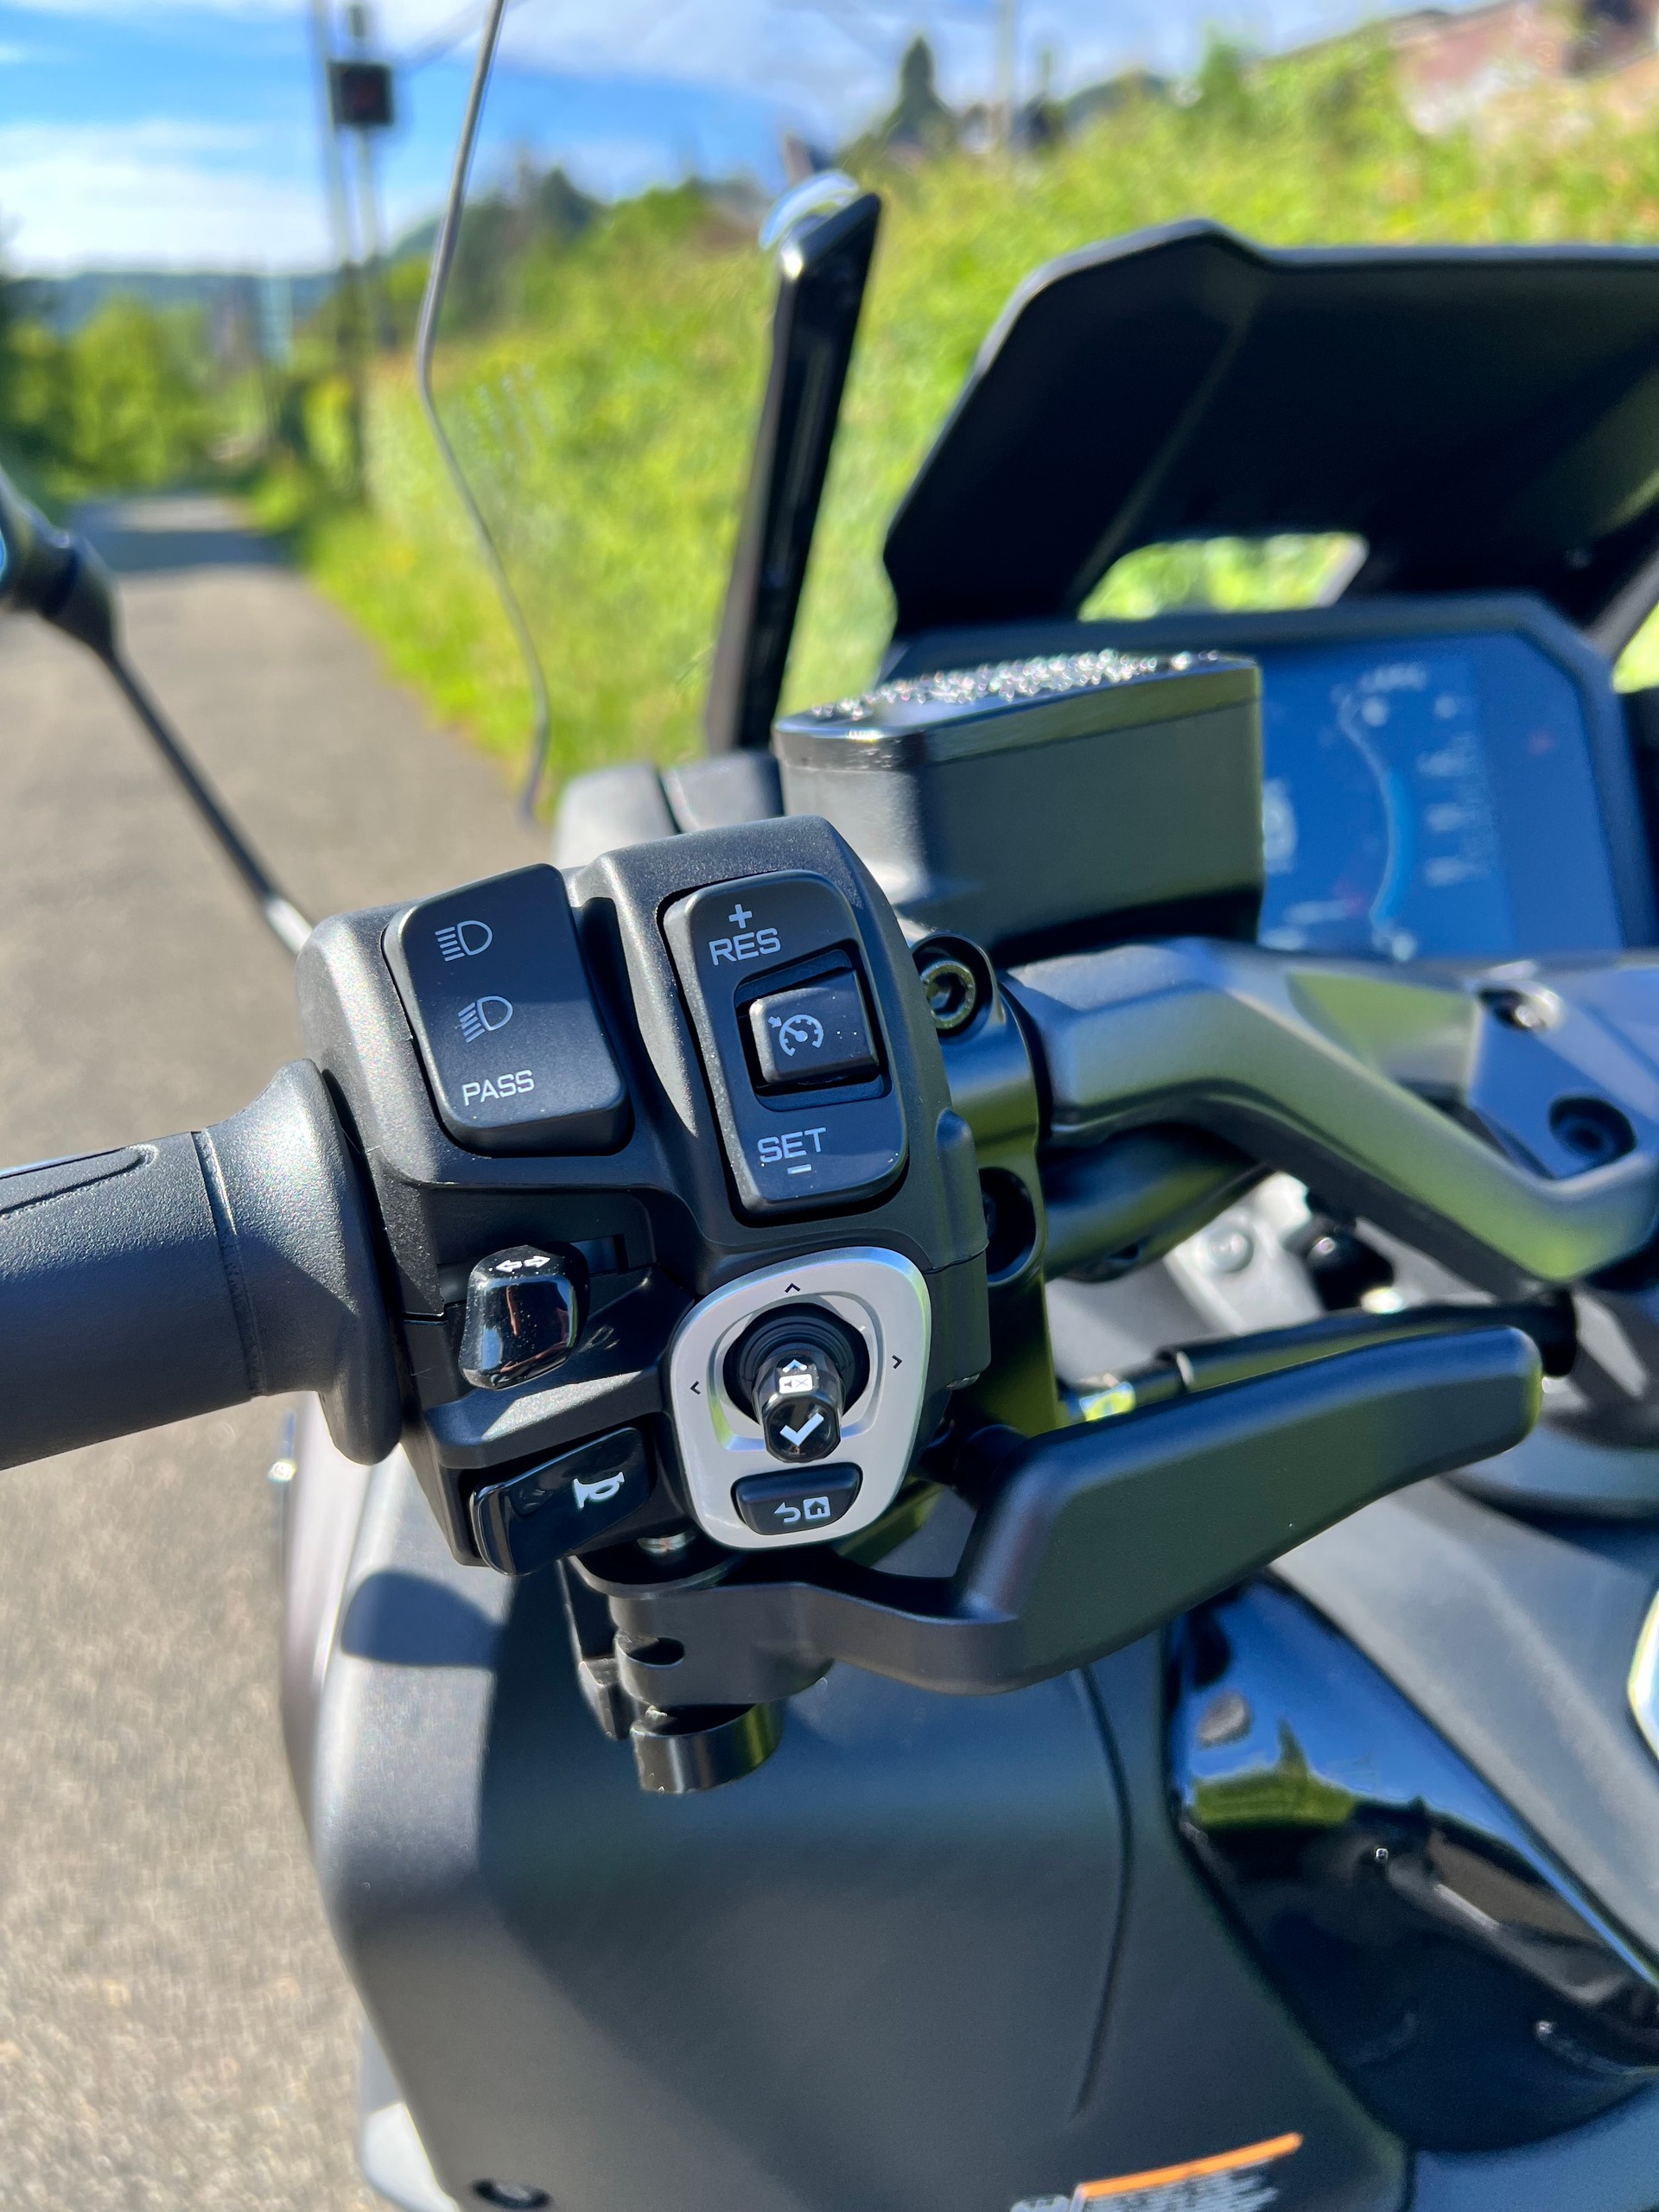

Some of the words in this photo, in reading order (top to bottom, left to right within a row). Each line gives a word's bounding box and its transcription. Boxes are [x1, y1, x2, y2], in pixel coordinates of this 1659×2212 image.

[709, 927, 781, 966] RES
[461, 1070, 535, 1106] PASS
[757, 1127, 826, 1163] SET
